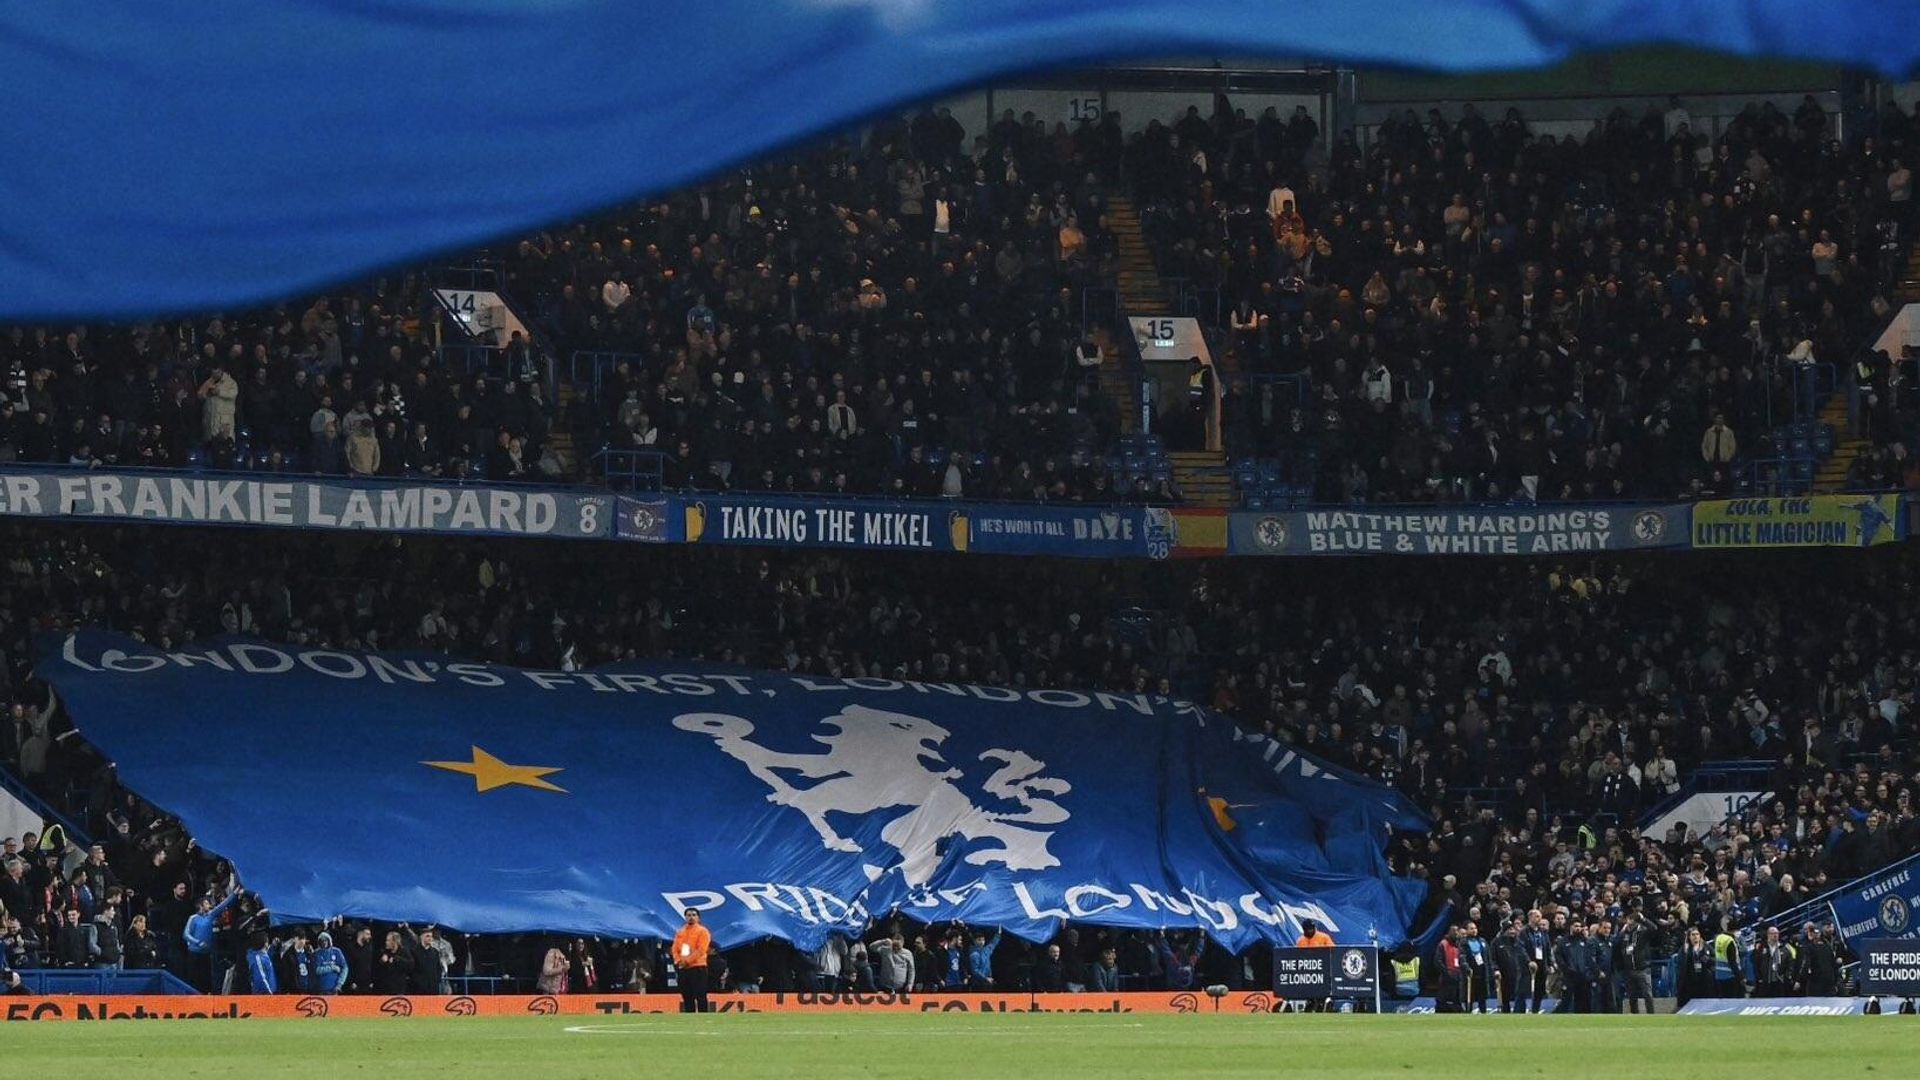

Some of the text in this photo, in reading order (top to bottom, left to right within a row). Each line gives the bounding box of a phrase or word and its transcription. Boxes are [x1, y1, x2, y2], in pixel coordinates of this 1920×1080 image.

[1070, 98, 1100, 121] 15
[450, 293, 475, 313] 14
[1148, 320, 1174, 340] 15
[58, 475, 293, 525] FRANKIE
[308, 484, 556, 534] LAMPARD
[580, 504, 597, 533] 8
[721, 506, 933, 547] TAKING THE MIKEL
[1306, 510, 1610, 534] MATTHEW HARDING'S
[1310, 531, 1610, 554] BLUE & WHITE ARMY
[1697, 521, 1847, 545] LITTLE MAGICIAN
[521, 671, 776, 698] FIRST,
[1281, 960, 1323, 971] THE PRIDE
[1870, 952, 1889, 965] THE
[1289, 974, 1324, 985] LONDON
[1869, 969, 1879, 980] OF
